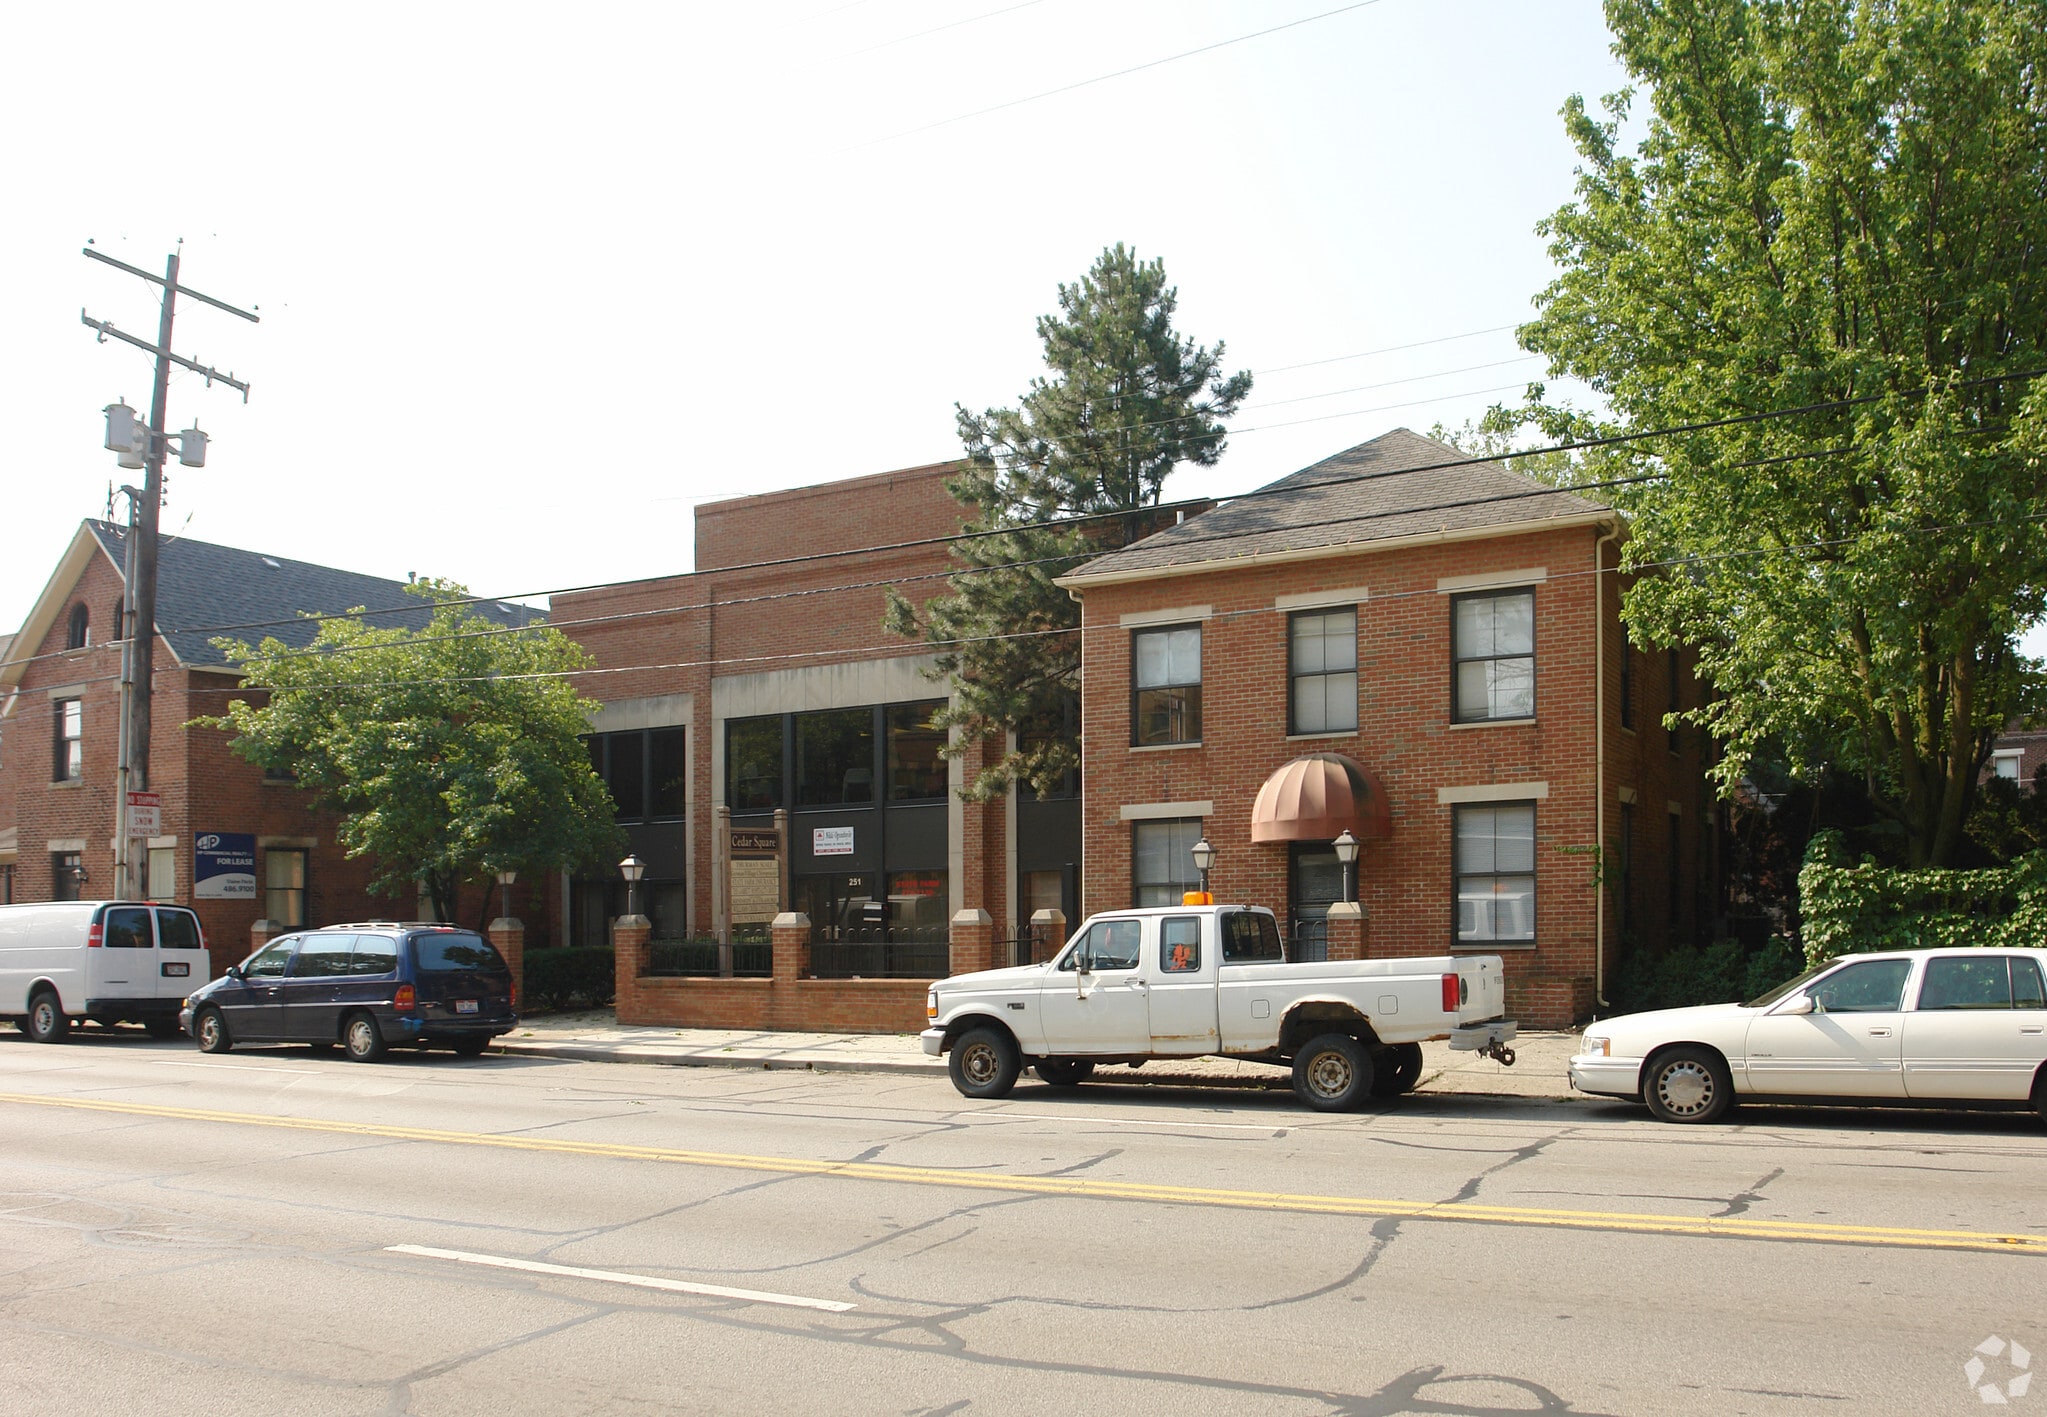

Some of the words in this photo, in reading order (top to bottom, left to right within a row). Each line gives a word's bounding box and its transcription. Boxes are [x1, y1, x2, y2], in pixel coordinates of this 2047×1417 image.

[134, 817, 153, 825] SNOW
[732, 835, 752, 847] Cedar
[753, 836, 776, 849] Square
[216, 857, 231, 865] FOR
[231, 858, 254, 866] LEASE
[848, 878, 861, 886] 251
